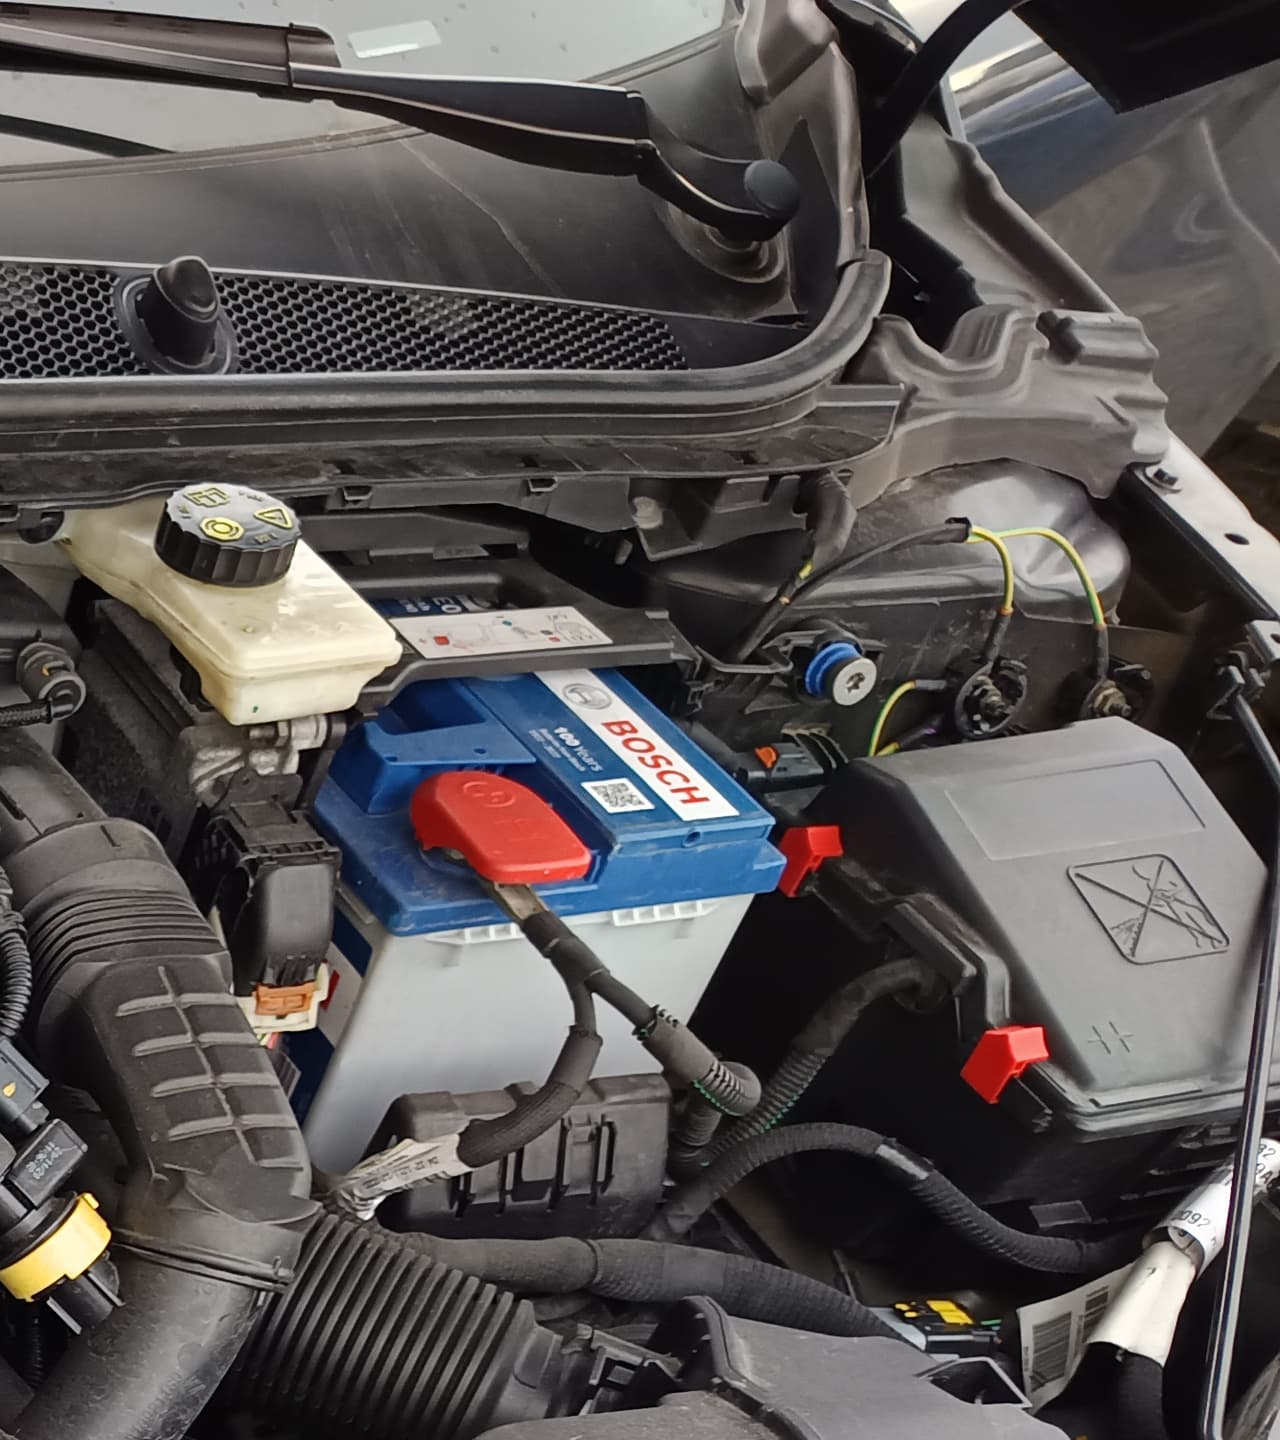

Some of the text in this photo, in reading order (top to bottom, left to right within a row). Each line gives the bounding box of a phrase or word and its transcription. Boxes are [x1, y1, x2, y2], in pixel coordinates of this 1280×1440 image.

[554, 726, 581, 747] 100
[576, 745, 604, 772] Years
[601, 720, 711, 805] BOSCH
